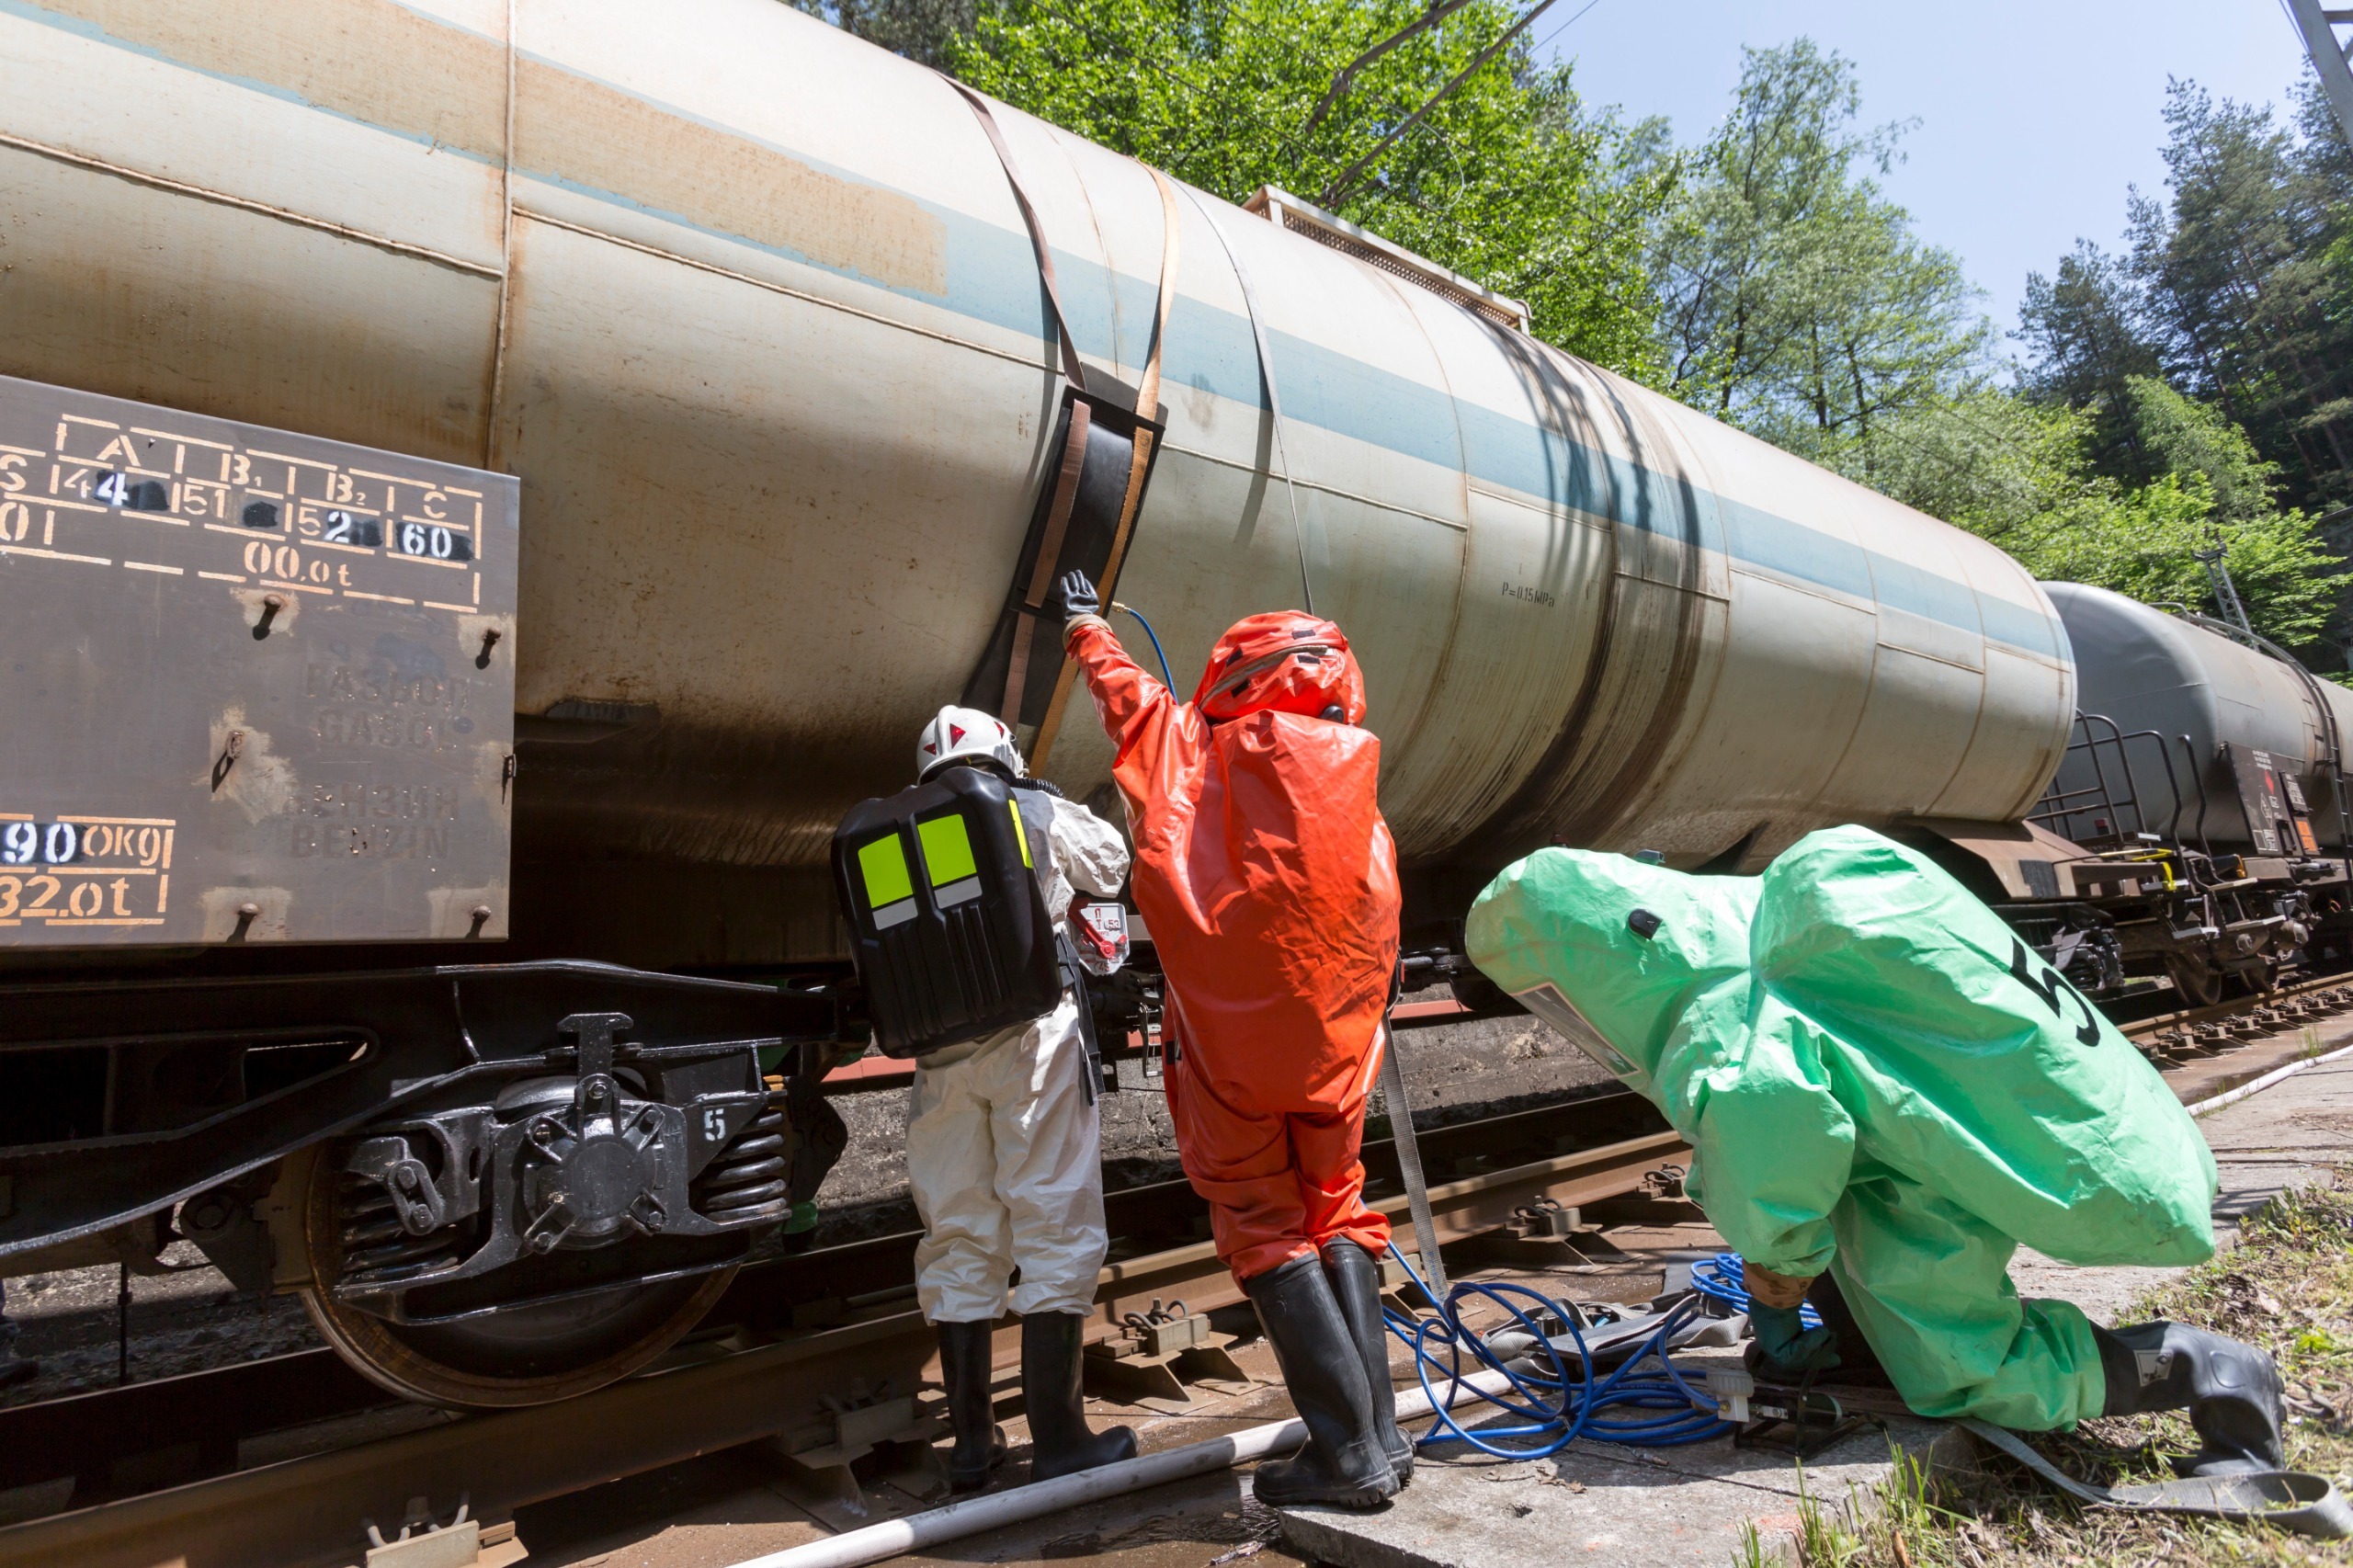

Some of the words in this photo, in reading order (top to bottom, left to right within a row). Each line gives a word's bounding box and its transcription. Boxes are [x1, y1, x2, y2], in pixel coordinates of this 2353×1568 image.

[97, 435, 141, 466] A
[424, 491, 448, 518] C
[403, 523, 452, 558] 60
[2008, 935, 2101, 1048] 5
[704, 1108, 726, 1142] 5
